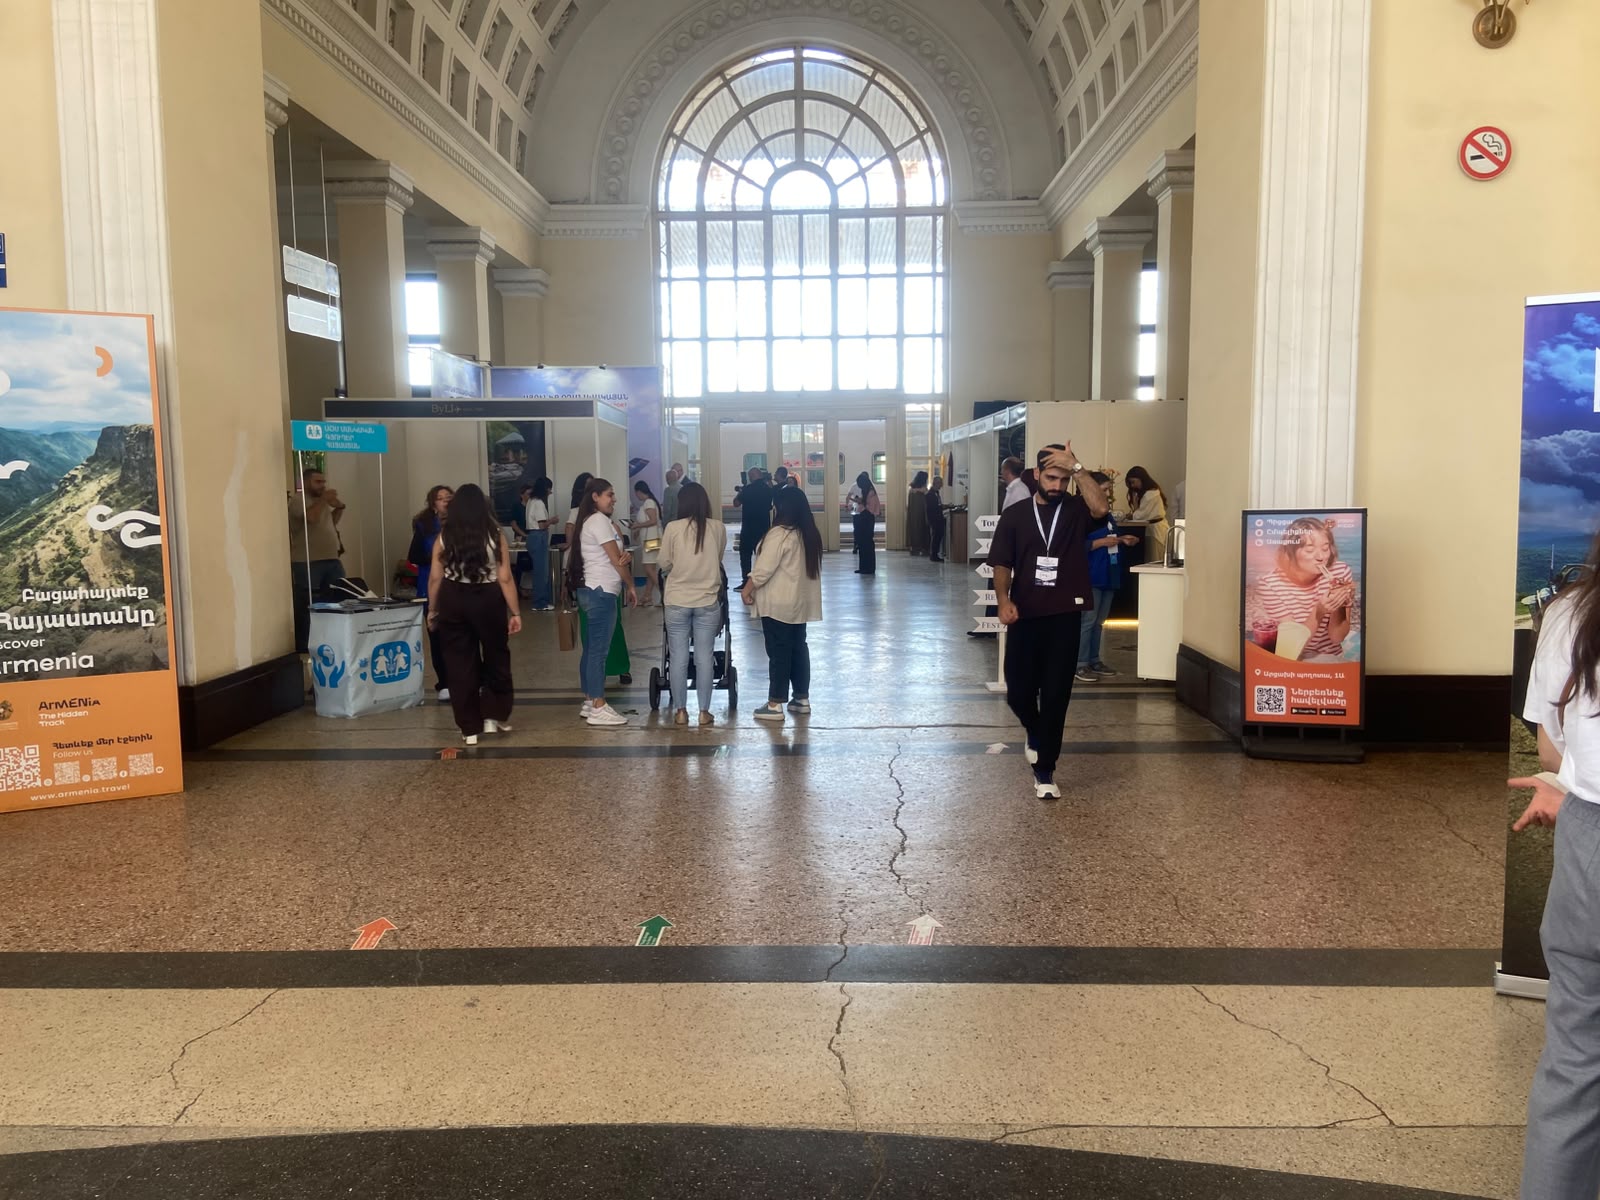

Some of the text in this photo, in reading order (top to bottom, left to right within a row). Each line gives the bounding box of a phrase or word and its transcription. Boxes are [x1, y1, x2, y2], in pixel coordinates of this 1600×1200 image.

[22, 584, 149, 604] Բացահայտեք
[0, 652, 94, 675] rmenia
[53, 750, 81, 759] Follow
[30, 783, 131, 801] www.armenia.travel
